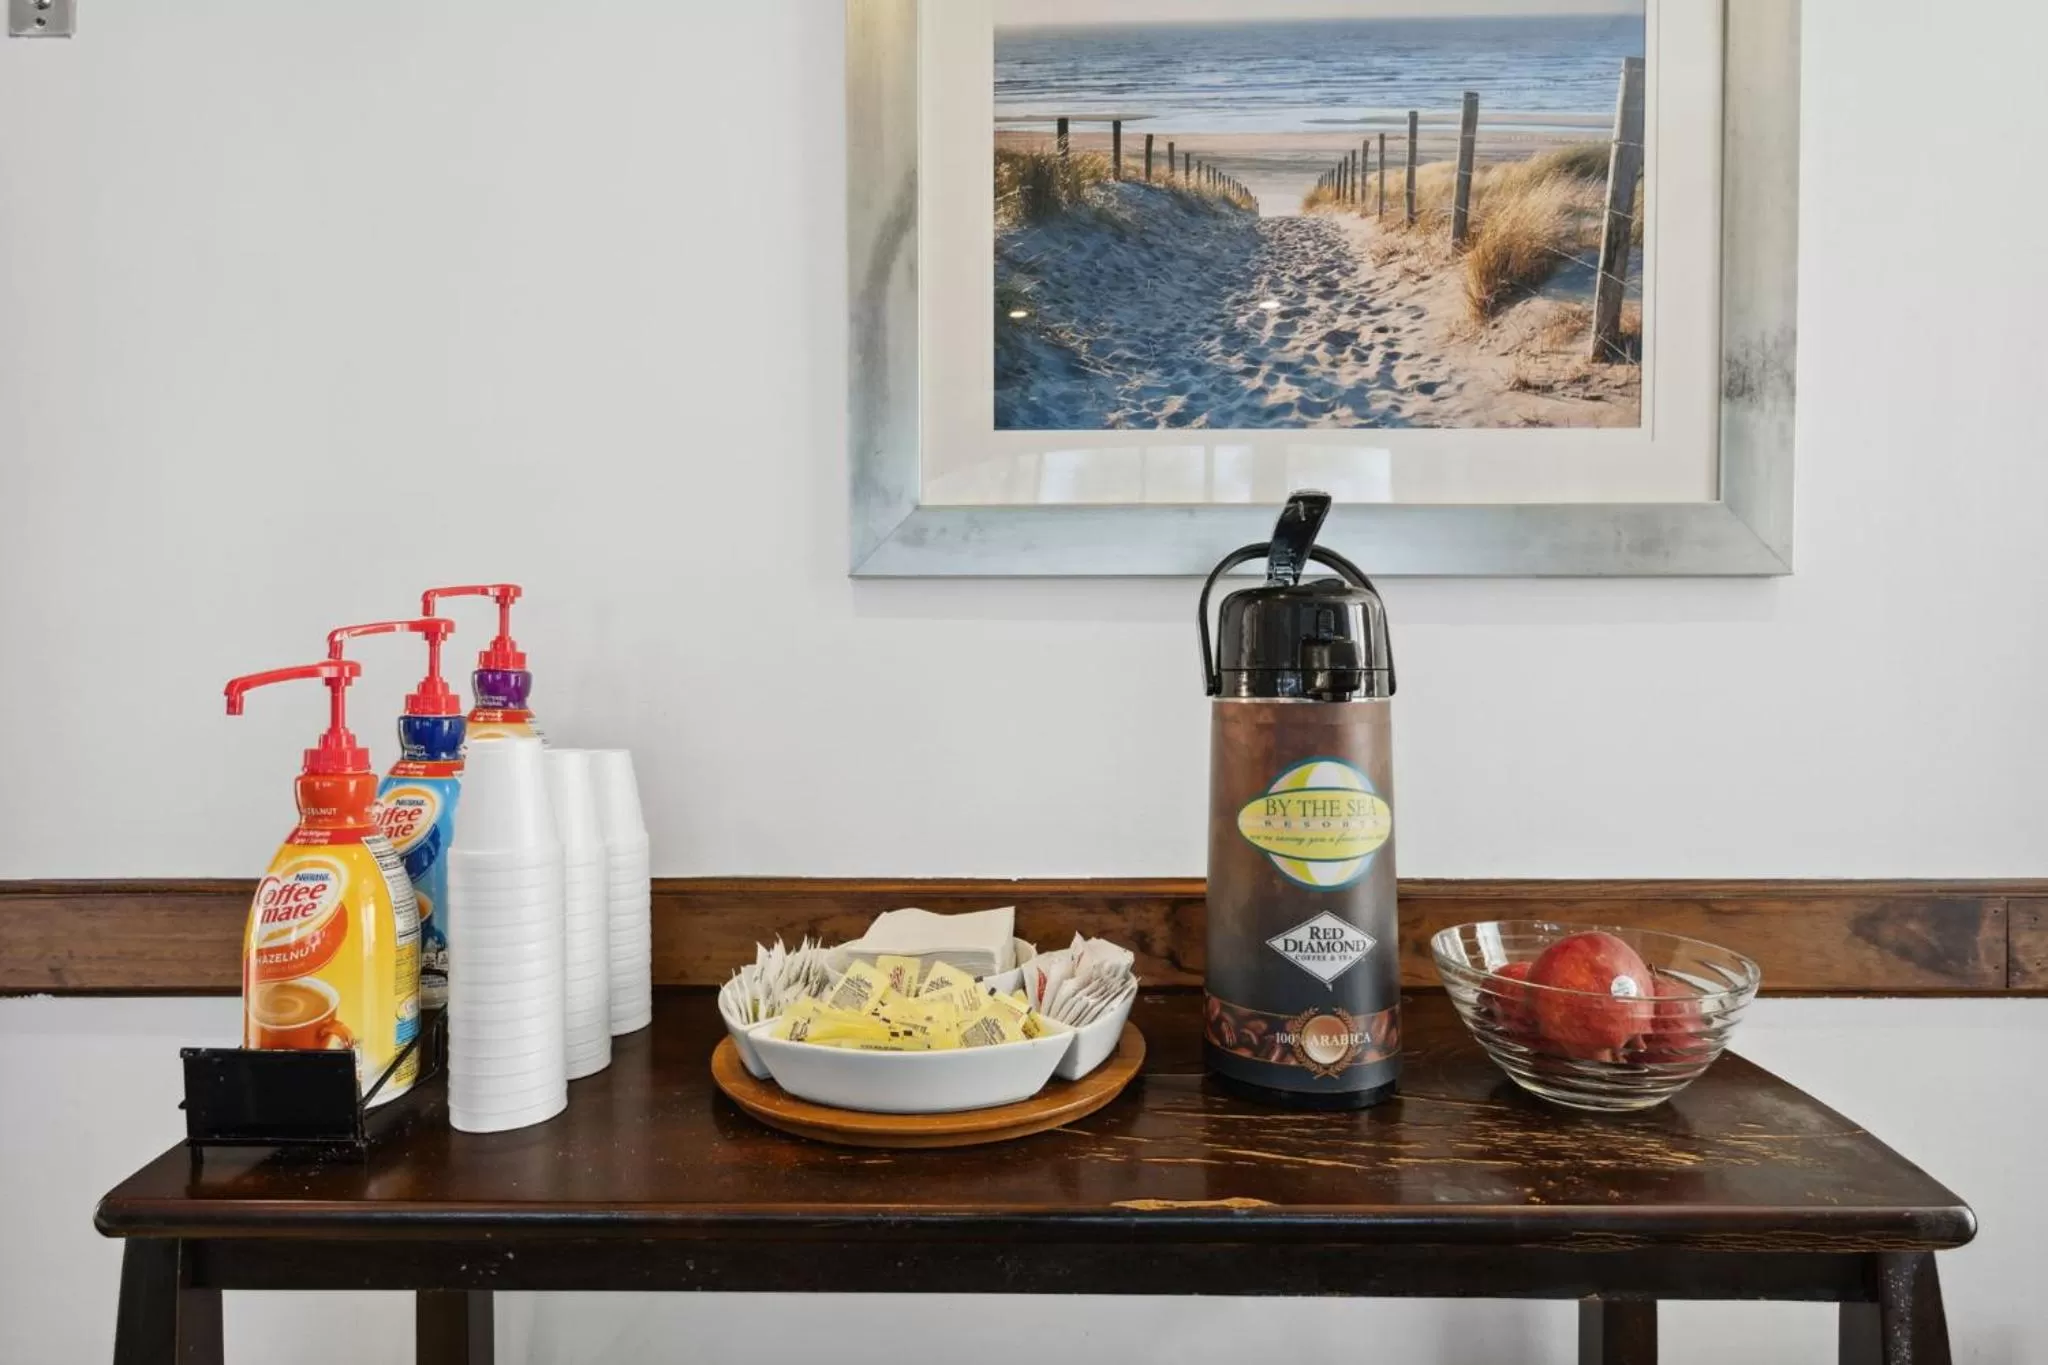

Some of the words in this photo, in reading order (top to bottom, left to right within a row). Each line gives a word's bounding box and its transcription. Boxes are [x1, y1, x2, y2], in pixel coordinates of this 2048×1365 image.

[1265, 799, 1291, 817] BY
[1296, 799, 1342, 818] THE
[1347, 799, 1377, 817] SEA
[257, 875, 327, 906] Coffee
[261, 902, 317, 925] mate
[1309, 926, 1344, 940] RED
[1283, 938, 1366, 953] DIAMOND
[1295, 954, 1326, 962] COFFEE
[1309, 1032, 1372, 1047] ARABICA
